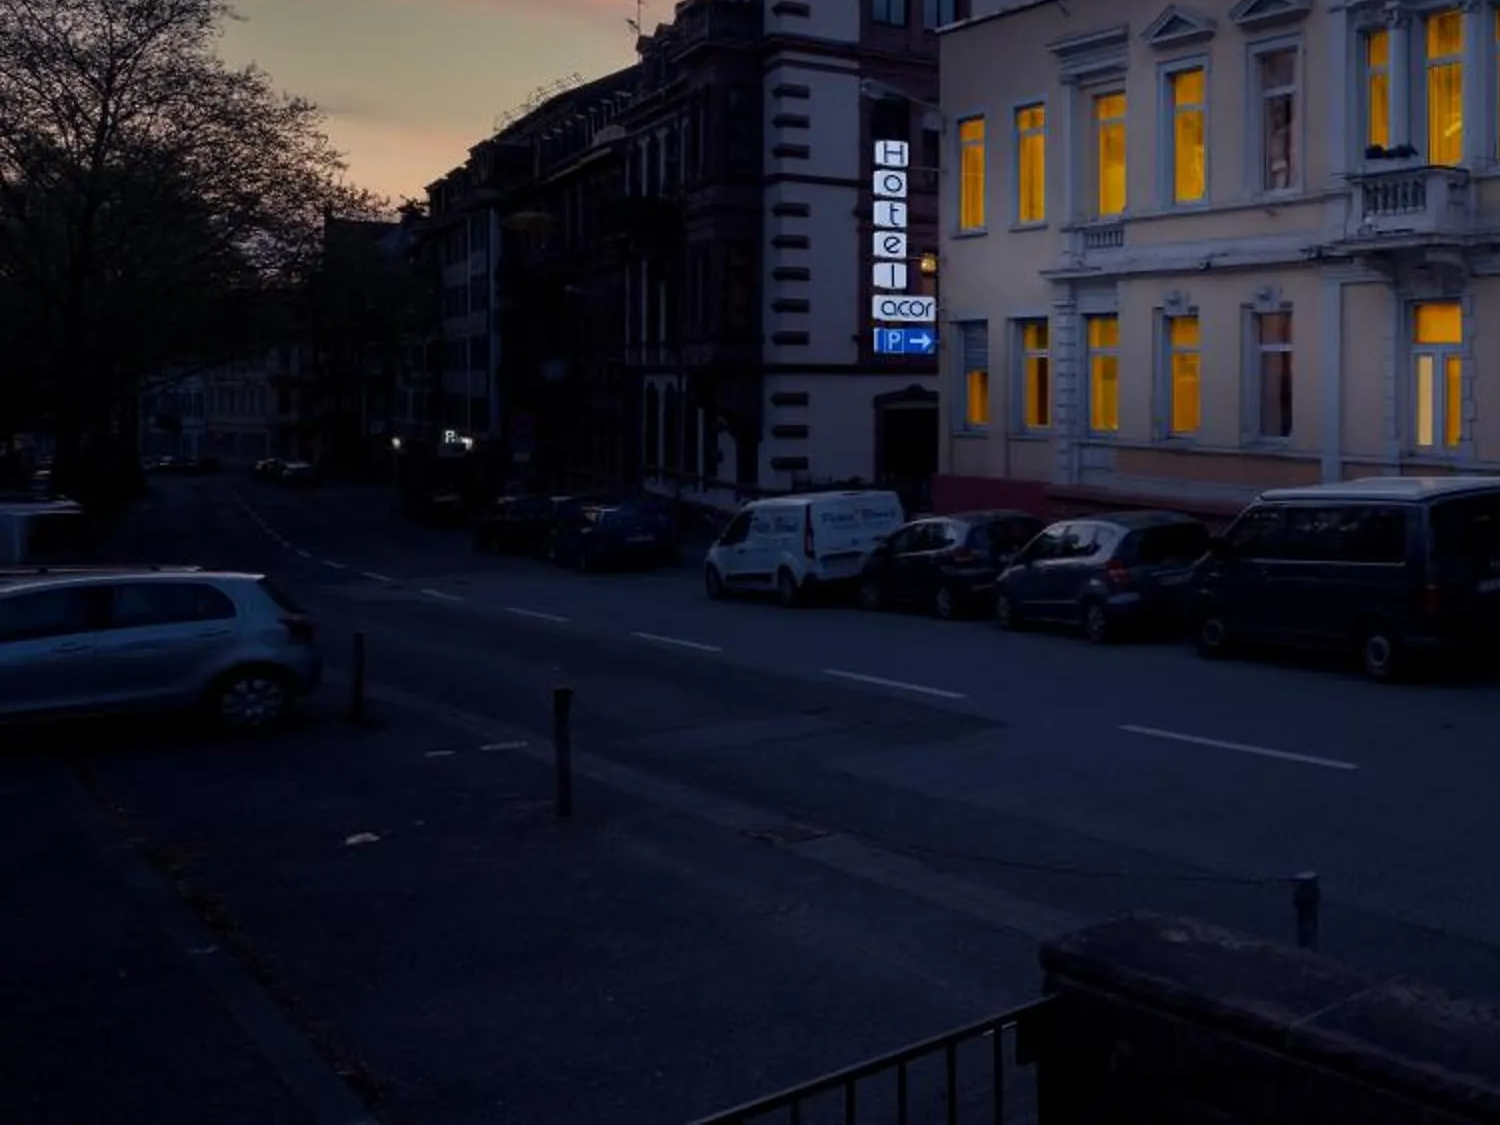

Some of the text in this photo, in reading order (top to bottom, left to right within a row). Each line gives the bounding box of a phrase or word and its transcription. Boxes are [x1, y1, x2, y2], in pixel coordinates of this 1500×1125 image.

[882, 142, 906, 288] Hotel
[880, 299, 933, 318] acor
[889, 332, 901, 351] P
